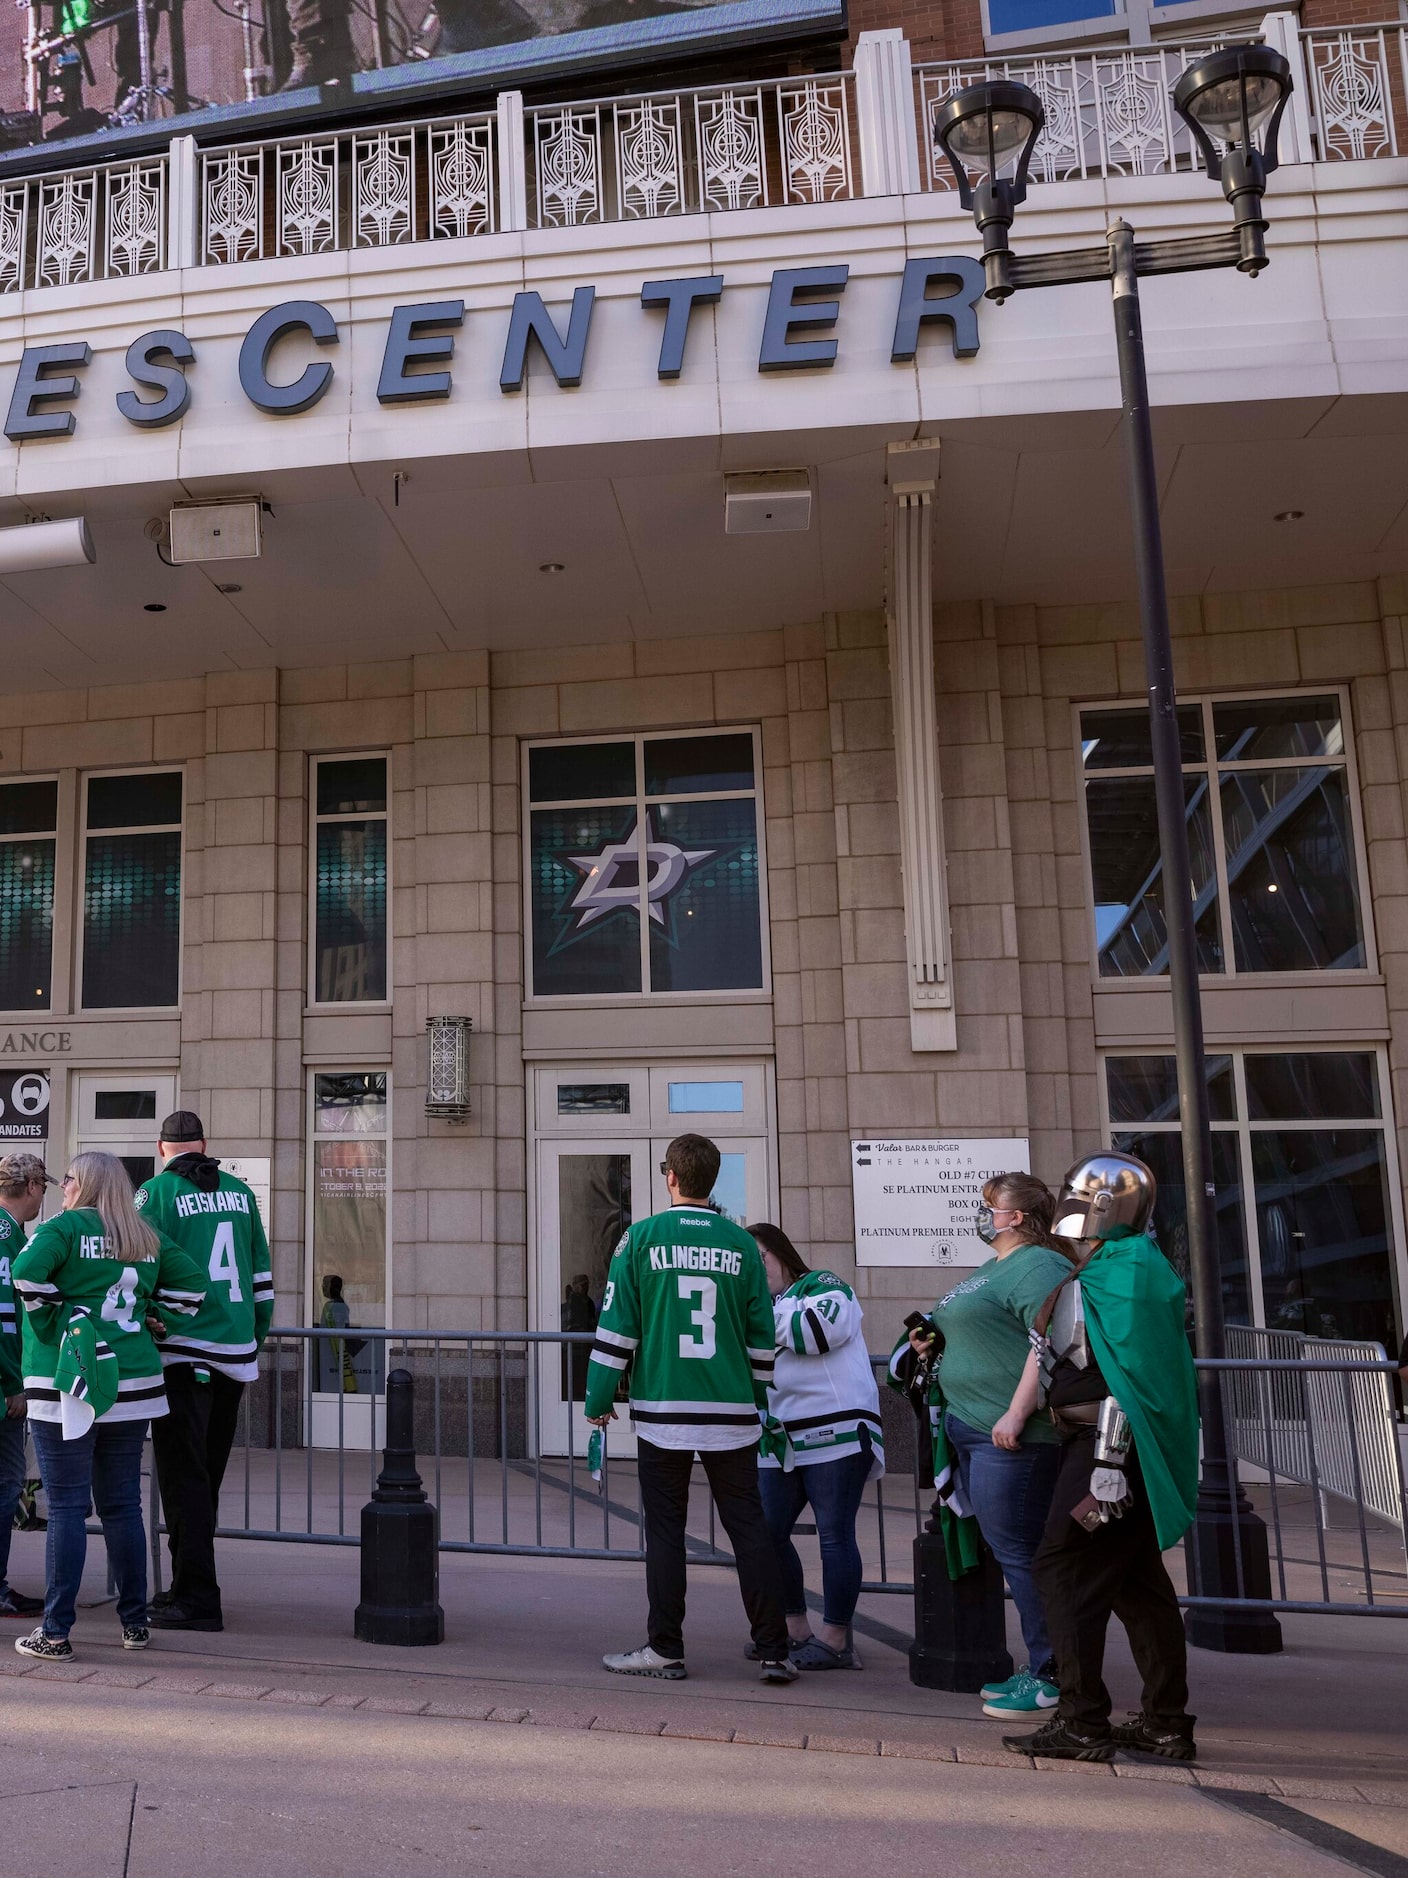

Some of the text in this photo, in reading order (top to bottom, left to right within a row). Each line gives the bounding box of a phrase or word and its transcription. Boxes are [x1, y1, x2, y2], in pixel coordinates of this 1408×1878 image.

[238, 255, 986, 416] CENTER
[875, 1144, 903, 1152] Valor
[913, 1157, 972, 1165] HANGAR
[335, 1168, 365, 1177] THE
[939, 1171, 961, 1180] OLD
[964, 1171, 975, 1180] #7
[883, 1186, 894, 1194] SE
[897, 1186, 949, 1194] PLATINUM
[175, 1191, 250, 1218] HEISKANEN
[949, 1200, 968, 1208] BOX
[680, 1217, 711, 1227] Reebok
[861, 1228, 910, 1236] PLATINUM
[912, 1228, 955, 1236] PREMIER
[208, 1221, 244, 1303] 4
[649, 1245, 742, 1276] KLINGBERG
[100, 1266, 141, 1333] 4
[677, 1275, 718, 1360] 3
